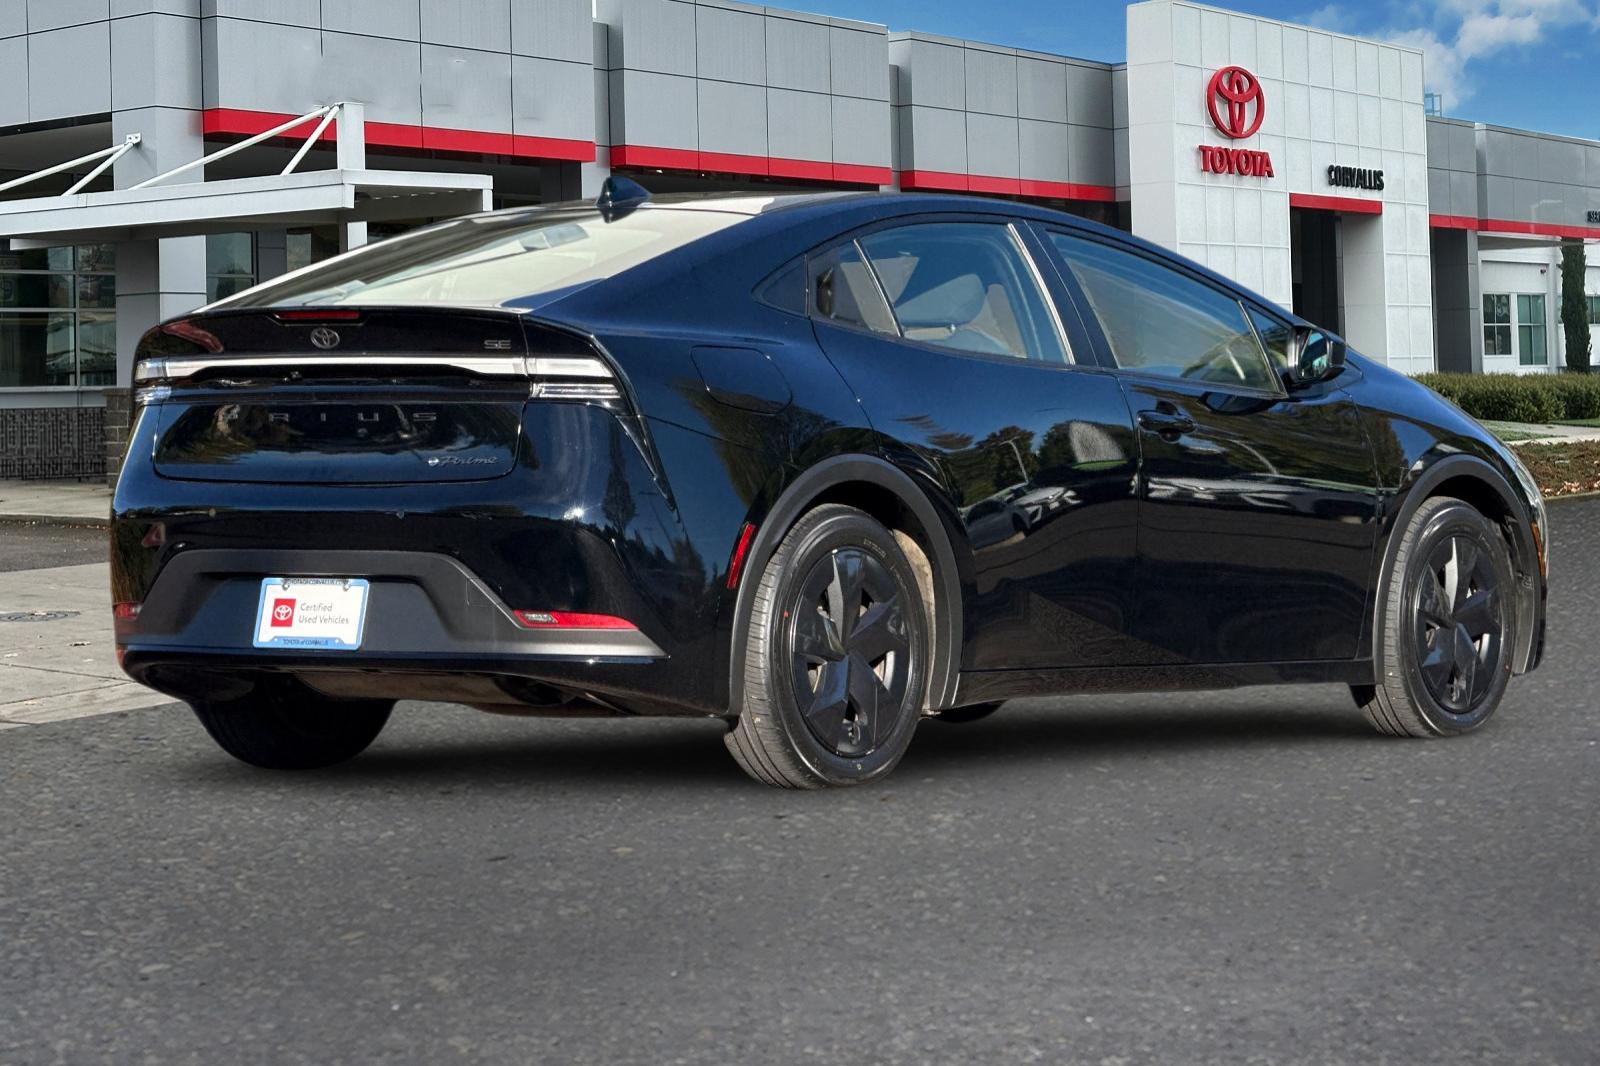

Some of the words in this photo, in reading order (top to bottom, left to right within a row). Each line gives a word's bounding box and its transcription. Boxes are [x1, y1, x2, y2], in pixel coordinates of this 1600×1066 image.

[1199, 145, 1274, 178] TOYOTA
[1327, 165, 1385, 190] CORVALLIS
[484, 340, 511, 349] SE
[300, 603, 333, 612] Certified
[298, 615, 318, 624] Used
[319, 615, 350, 625] Vehicles
